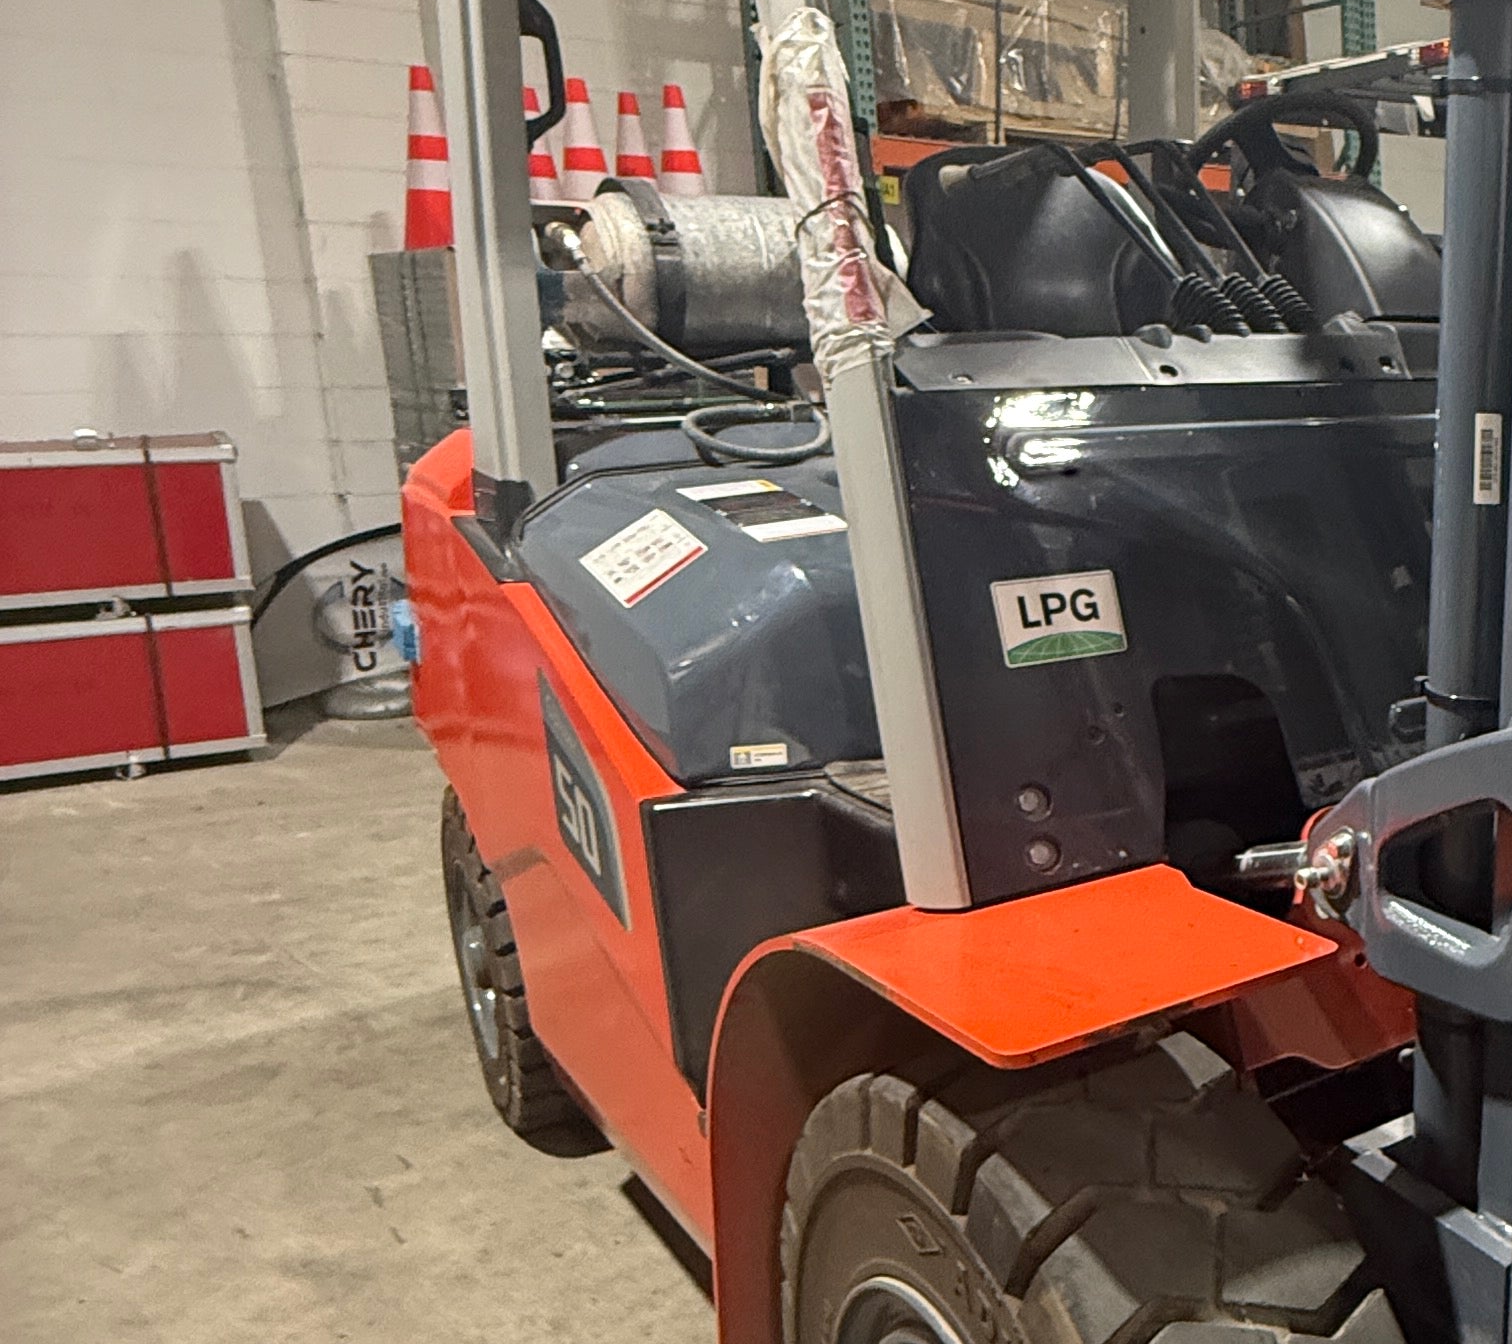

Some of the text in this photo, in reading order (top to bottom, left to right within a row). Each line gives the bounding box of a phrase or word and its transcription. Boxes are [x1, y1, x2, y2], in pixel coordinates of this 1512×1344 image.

[349, 560, 376, 672] CHERY
[1017, 588, 1100, 629] LPG
[553, 753, 602, 877] 50
